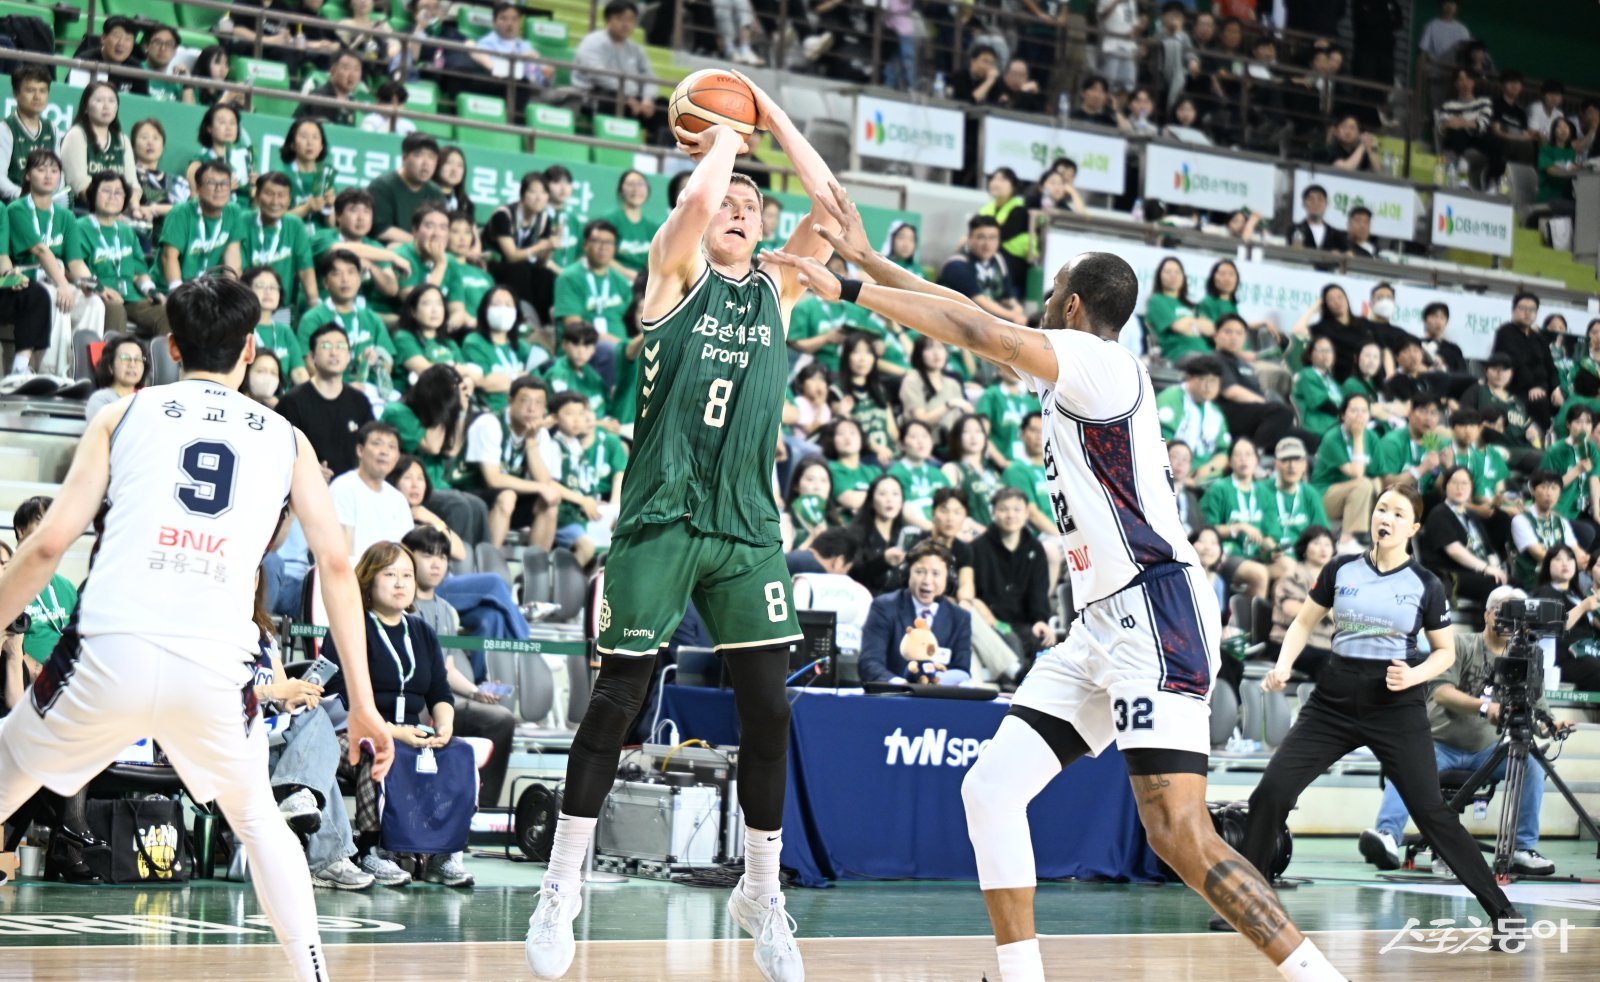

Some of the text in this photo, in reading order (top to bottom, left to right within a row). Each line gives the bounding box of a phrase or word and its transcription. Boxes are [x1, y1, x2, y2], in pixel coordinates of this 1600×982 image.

[704, 377, 733, 428] 8
[174, 438, 240, 519] 9
[158, 526, 229, 557] BNK
[147, 550, 230, 584] 금융그룹
[764, 580, 788, 622] 8
[1113, 697, 1154, 732] 32
[884, 727, 948, 765] tvN
